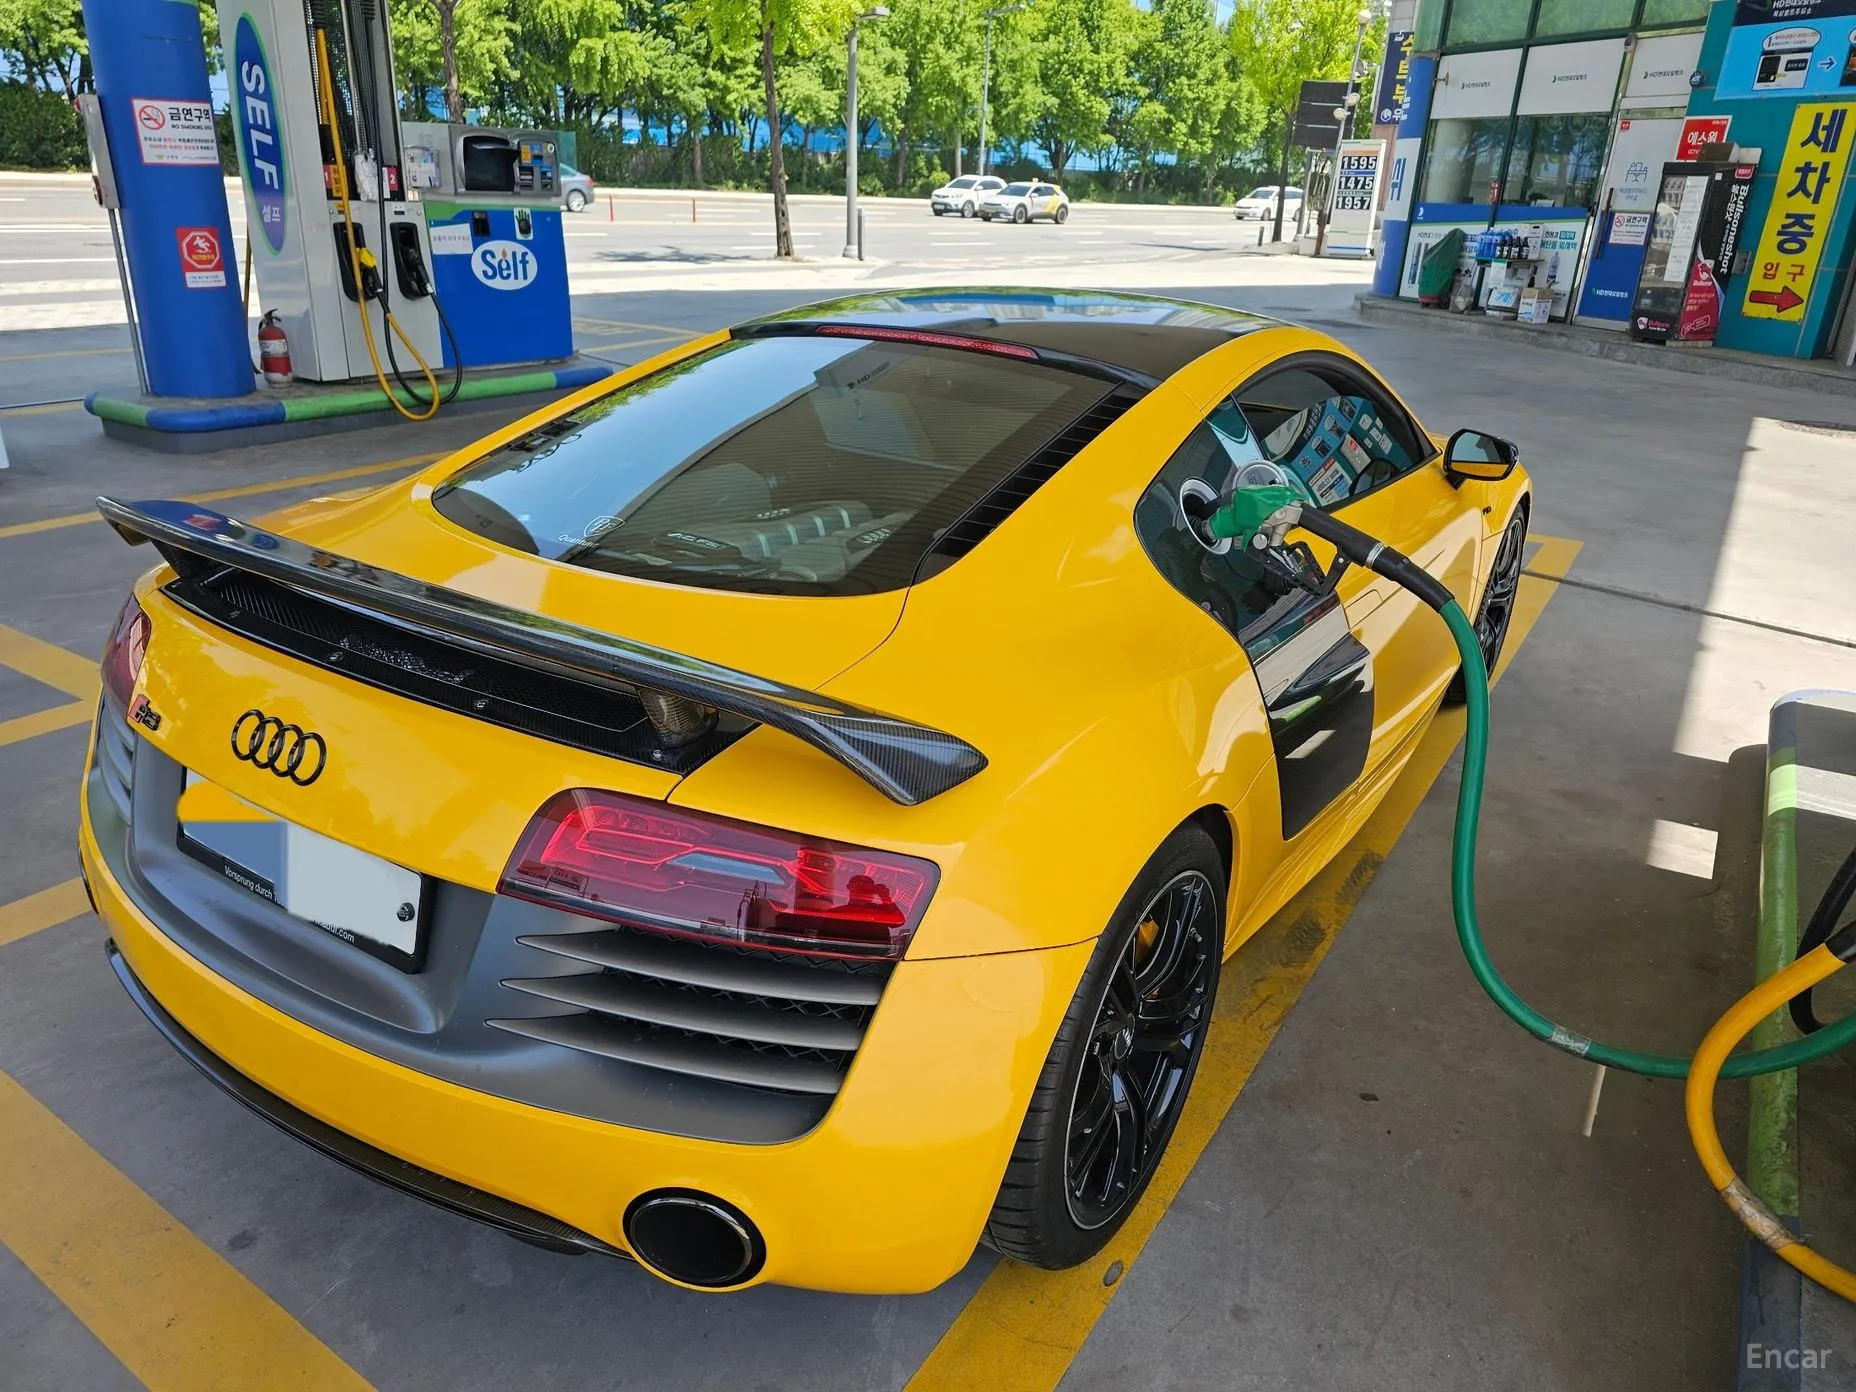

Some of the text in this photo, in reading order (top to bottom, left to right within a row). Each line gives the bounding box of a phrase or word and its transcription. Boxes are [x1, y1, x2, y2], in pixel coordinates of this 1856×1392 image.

[168, 107, 212, 122] 금연구역
[241, 60, 280, 190] SELF
[1342, 156, 1377, 170] 1595
[390, 174, 396, 184] 2
[1339, 176, 1374, 190] 1475
[1336, 196, 1371, 210] 1957
[262, 204, 281, 223] 셀프
[1719, 184, 1750, 275] Bullsoneshot
[481, 249, 529, 281] Self
[224, 865, 255, 891] Vorsprung
[254, 883, 273, 900] durch
